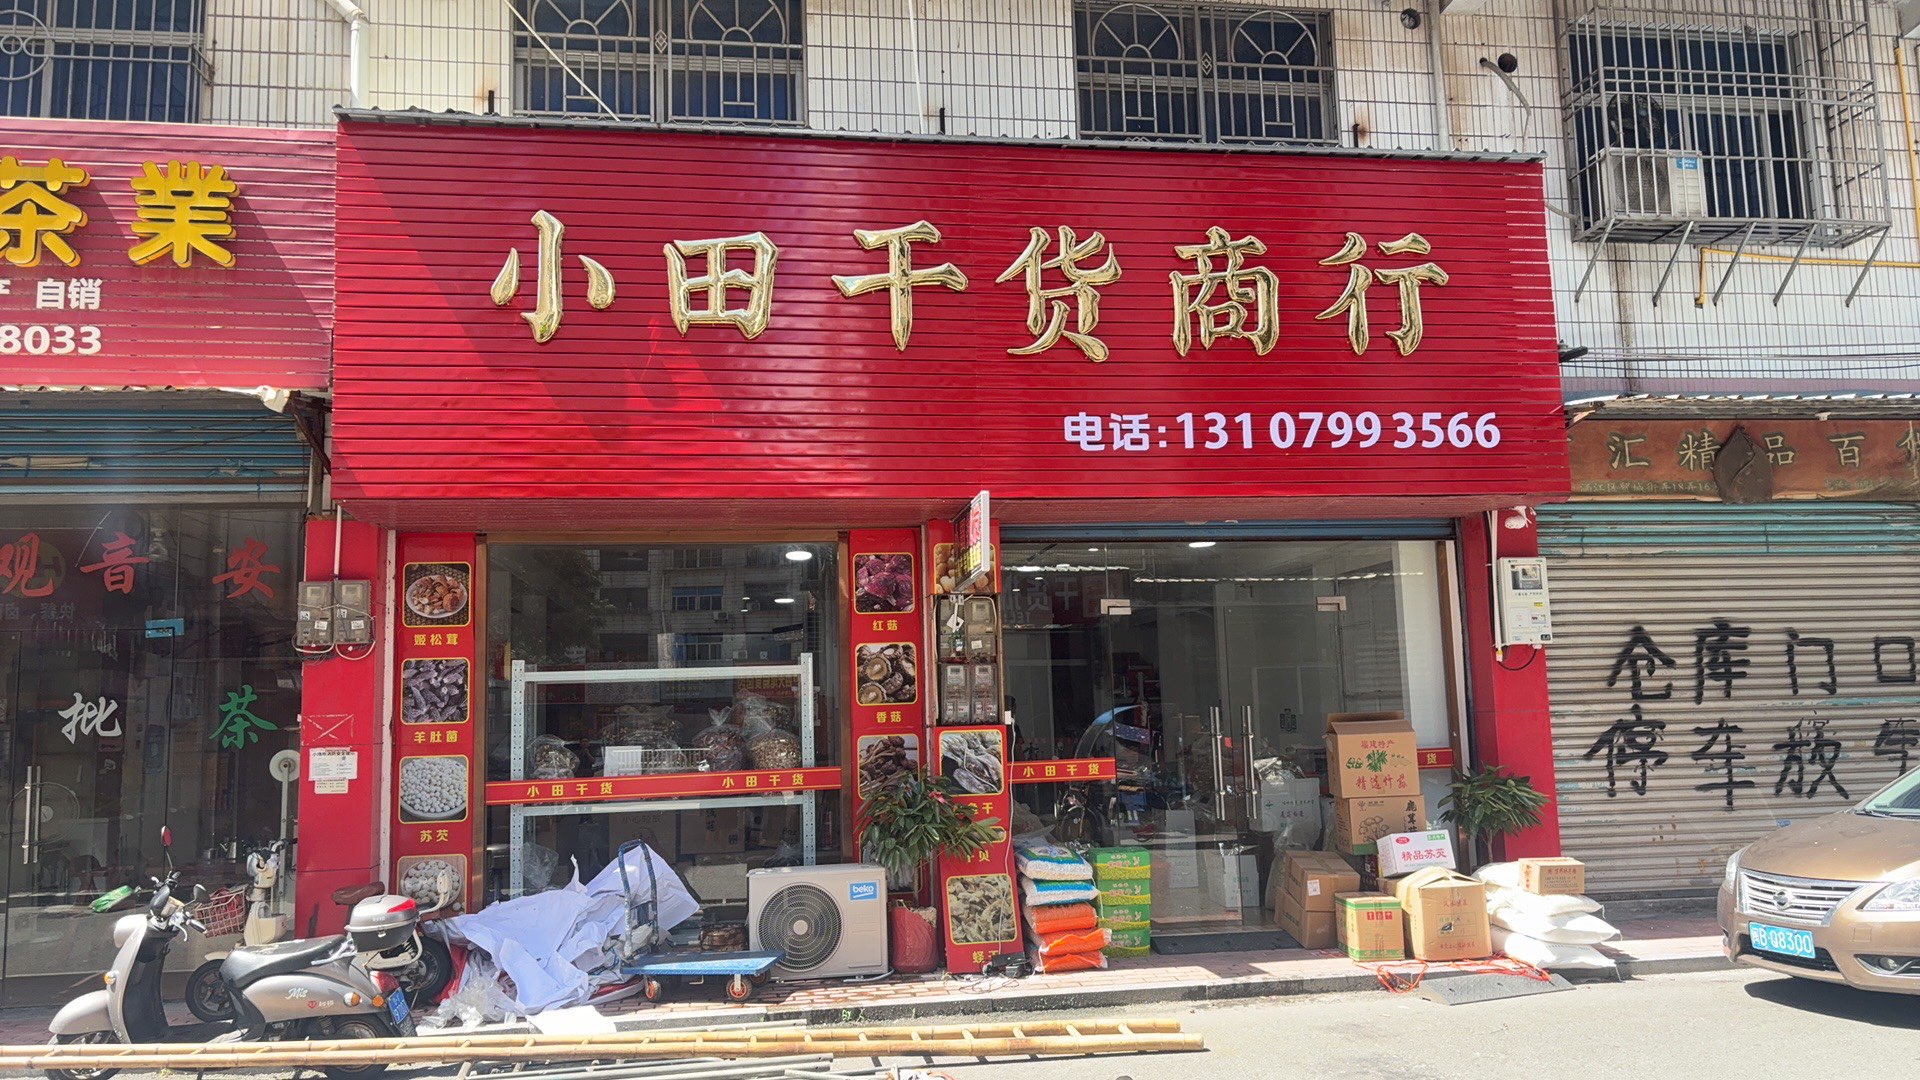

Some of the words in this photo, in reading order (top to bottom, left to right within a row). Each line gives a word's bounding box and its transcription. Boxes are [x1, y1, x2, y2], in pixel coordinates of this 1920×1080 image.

[490, 209, 1449, 363] 小田干货商行
[1269, 411, 1382, 449] 0799
[1392, 411, 1501, 449] 3566
[872, 620, 898, 631] 红菇
[1607, 618, 1918, 705] 仓库门口
[209, 685, 278, 749] 茶
[876, 710, 902, 723] 香菇
[413, 730, 459, 744] 羊肚菌
[1022, 762, 1101, 778] 小田干货
[722, 773, 804, 788] 小田干货
[526, 782, 614, 798] 小田干货
[852, 884, 875, 894] beko
